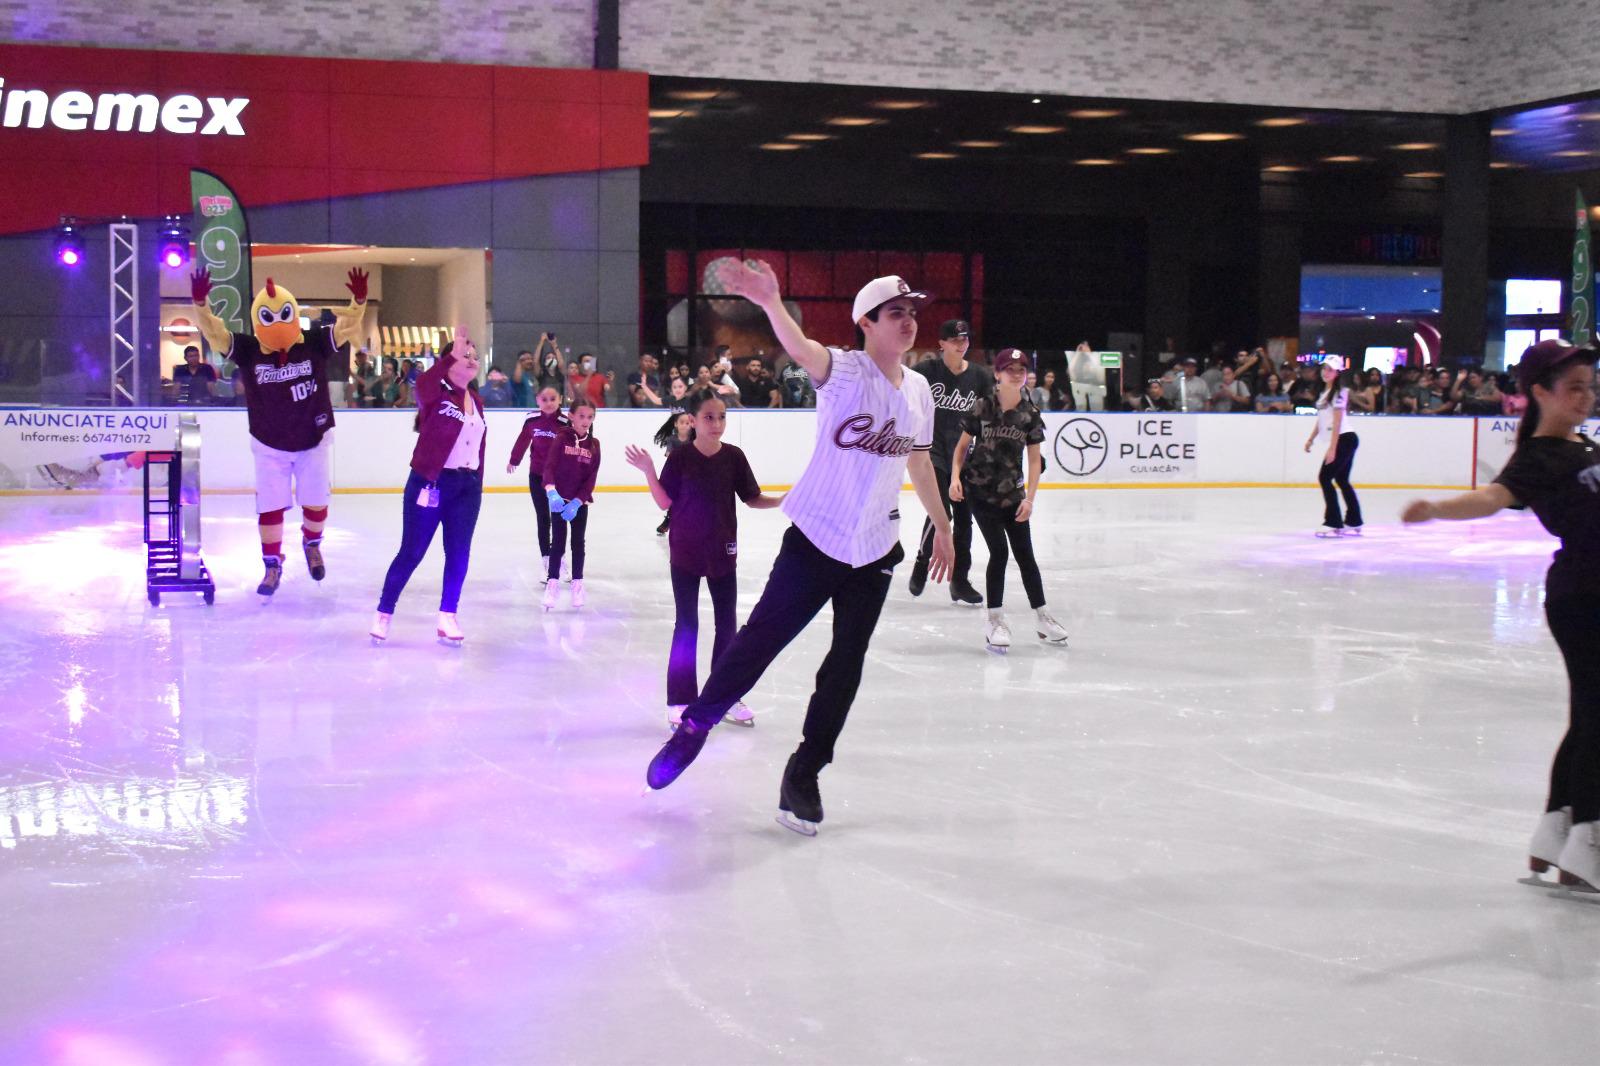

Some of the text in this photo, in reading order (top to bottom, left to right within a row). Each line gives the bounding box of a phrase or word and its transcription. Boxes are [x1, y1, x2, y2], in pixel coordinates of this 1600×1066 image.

[0, 77, 250, 136] nemex
[121, 413, 168, 432] AQUÍ
[1137, 420, 1173, 436] ICE
[21, 431, 151, 444] Informes: 6674716172
[1120, 443, 1196, 459] PLACE
